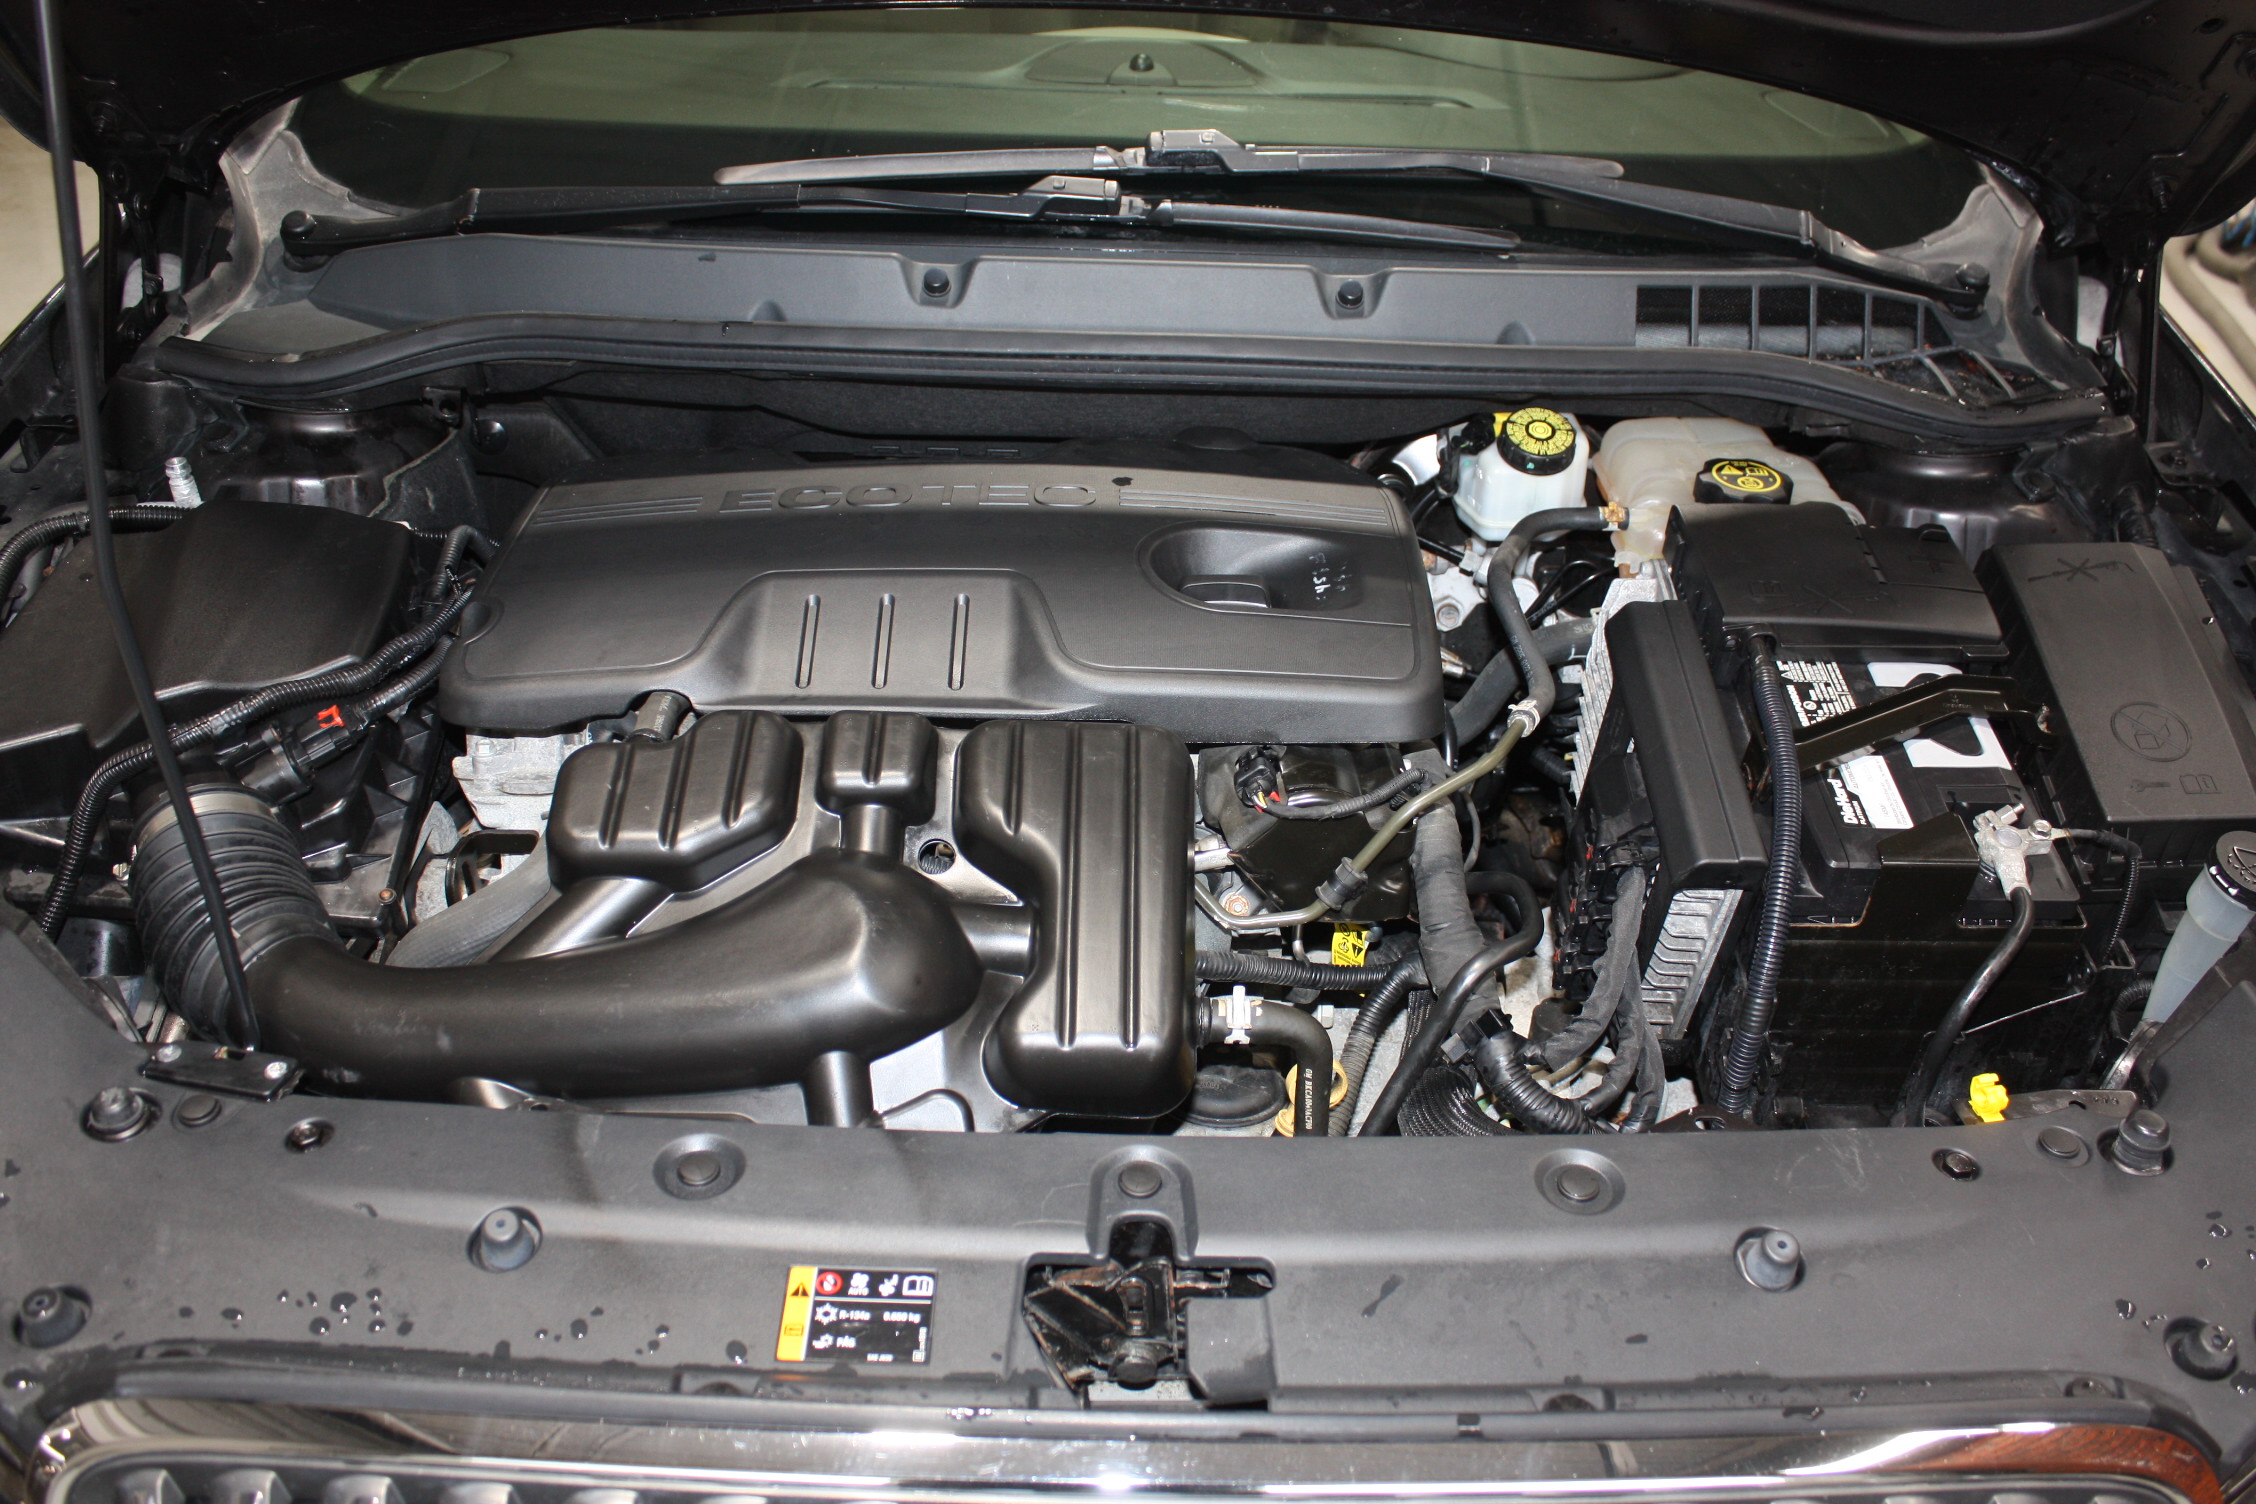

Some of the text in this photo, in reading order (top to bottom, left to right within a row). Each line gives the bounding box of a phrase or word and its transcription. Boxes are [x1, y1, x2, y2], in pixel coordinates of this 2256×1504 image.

[720, 484, 1096, 513] ECOTEC
[1827, 779, 1858, 824] DieHard
[1852, 801, 1867, 825] PLATINUM
[848, 1287, 869, 1296] AUTO
